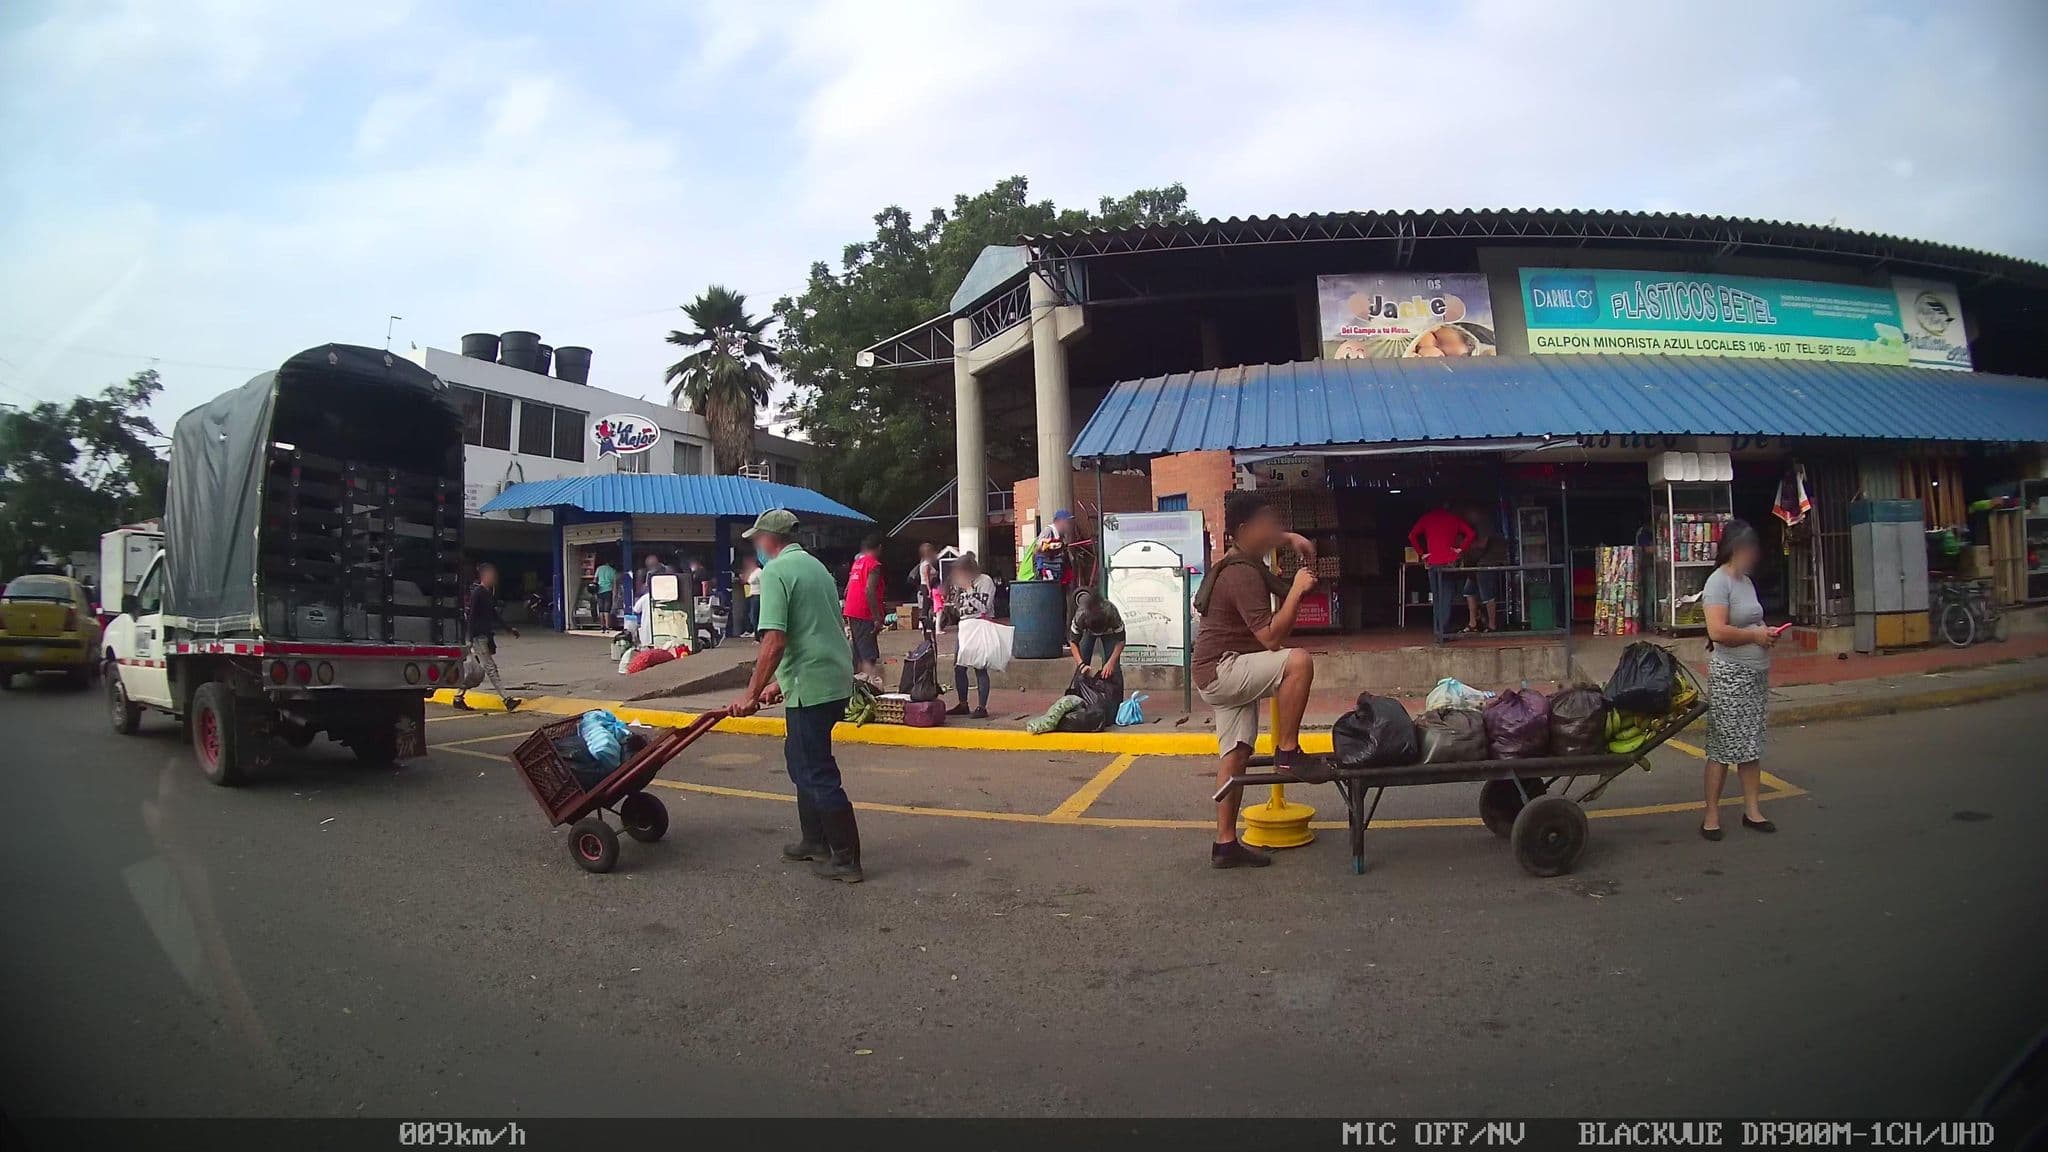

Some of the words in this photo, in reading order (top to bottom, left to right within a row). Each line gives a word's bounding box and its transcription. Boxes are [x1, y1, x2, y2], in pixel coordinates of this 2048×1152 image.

[1533, 288, 1576, 308] DARNEL
[1610, 281, 1718, 322] PLÁSTICOS
[1718, 285, 1777, 325] BETEL
[1353, 326, 1376, 337] Campo
[1594, 336, 1659, 349] MINORISTA
[1664, 338, 1693, 350] AZUL
[1696, 339, 1746, 351] LOCALES
[1749, 341, 1765, 352] 106
[1775, 343, 1791, 353] 107
[617, 432, 656, 448] Mejor
